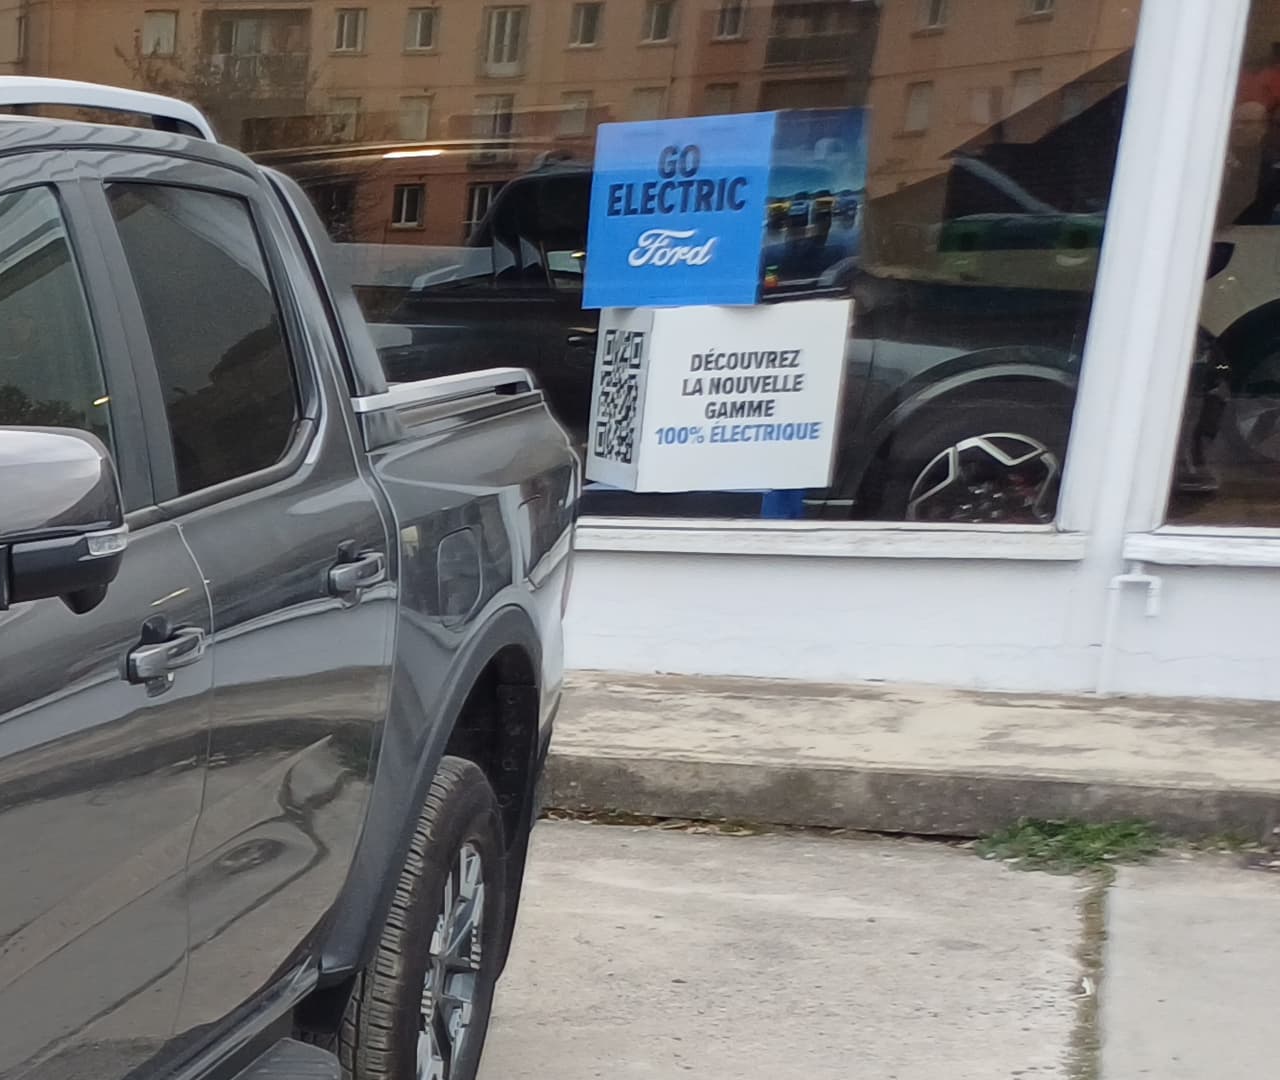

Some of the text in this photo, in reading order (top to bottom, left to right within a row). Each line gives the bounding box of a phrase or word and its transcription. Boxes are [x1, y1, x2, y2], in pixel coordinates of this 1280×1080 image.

[658, 144, 702, 178] GO
[607, 176, 749, 217] ELECTRIC
[628, 228, 718, 268] Ford
[690, 348, 801, 372] DÉCOUVREZ
[681, 374, 805, 397] LA NOUVELLE
[704, 399, 775, 420] GAMME
[655, 421, 823, 446] 100% ÉLECTRIQUE
